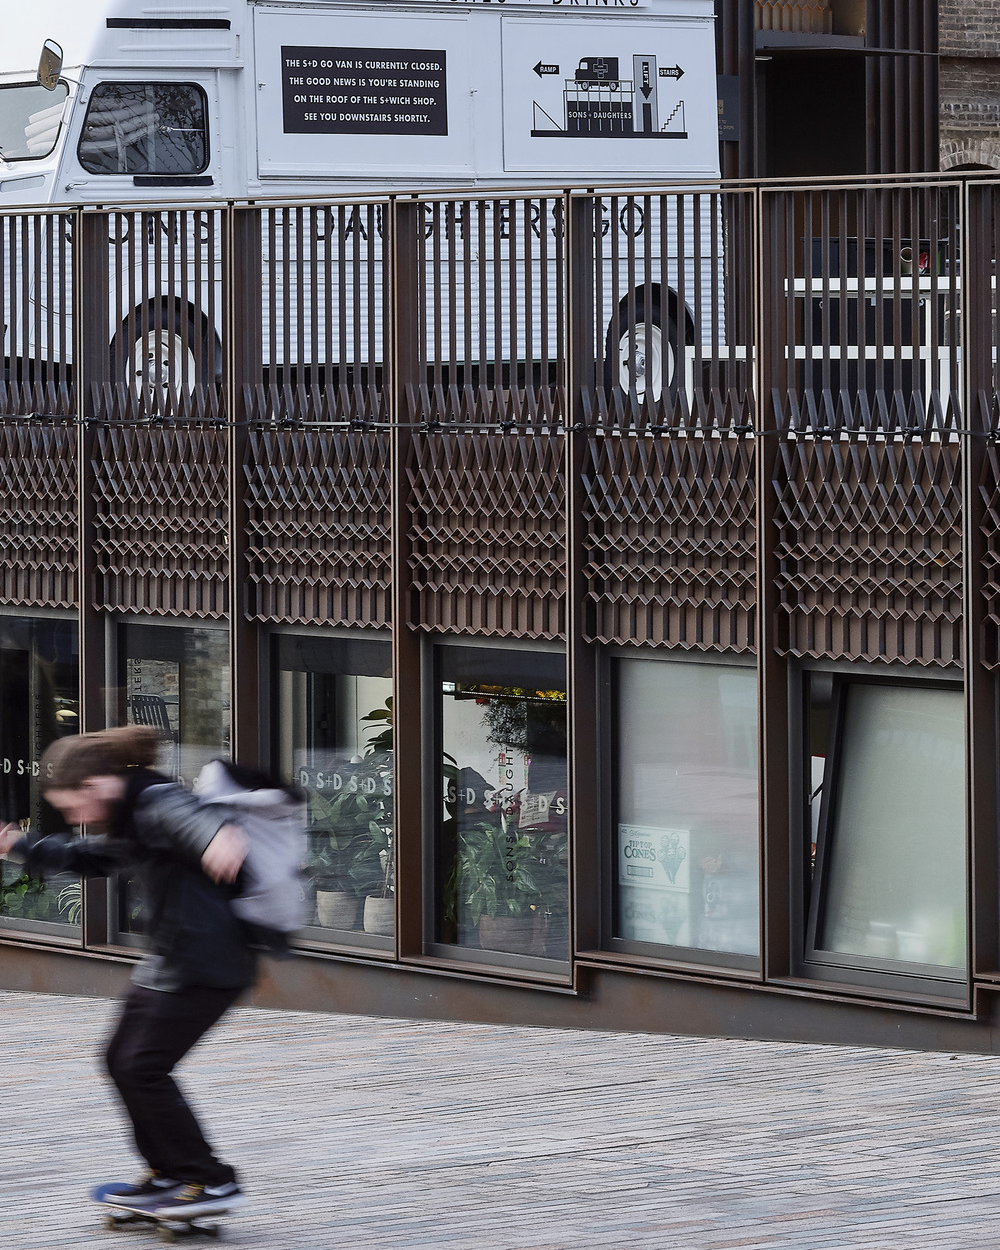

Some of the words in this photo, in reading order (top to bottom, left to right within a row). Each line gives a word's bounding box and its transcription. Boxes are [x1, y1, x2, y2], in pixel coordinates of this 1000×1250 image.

[286, 60, 300, 68] THE
[302, 60, 318, 68] S+D
[320, 60, 333, 68] GO
[336, 60, 352, 68] VAN
[356, 61, 362, 69] IS
[365, 61, 408, 70] CURRENTLY
[411, 62, 442, 71] CLOSED.
[289, 77, 304, 85] THE
[306, 78, 330, 86] GOOD
[334, 78, 356, 86] NEWS
[358, 78, 366, 86] IS
[368, 78, 398, 87] YOU'RE
[400, 79, 440, 88] STANDING
[294, 95, 306, 103] ON
[309, 95, 324, 103] THE
[326, 96, 348, 104] ROOF
[350, 96, 361, 104] OF
[363, 96, 378, 104] THE
[380, 96, 410, 104] S+WICH
[413, 97, 436, 105] SHOP.
[304, 112, 318, 120] SEE
[320, 113, 336, 121] YOU
[340, 113, 392, 122] DOWNSTAIRS
[394, 114, 430, 122] SHORTLY.
[594, 112, 632, 120] DAUGHTERS
[17, 760, 40, 776] S+D
[316, 772, 342, 790] S+D
[350, 775, 376, 794] S+D
[448, 786, 476, 804] S+D
[506, 836, 514, 882] SONS
[624, 845, 656, 862] CONES
